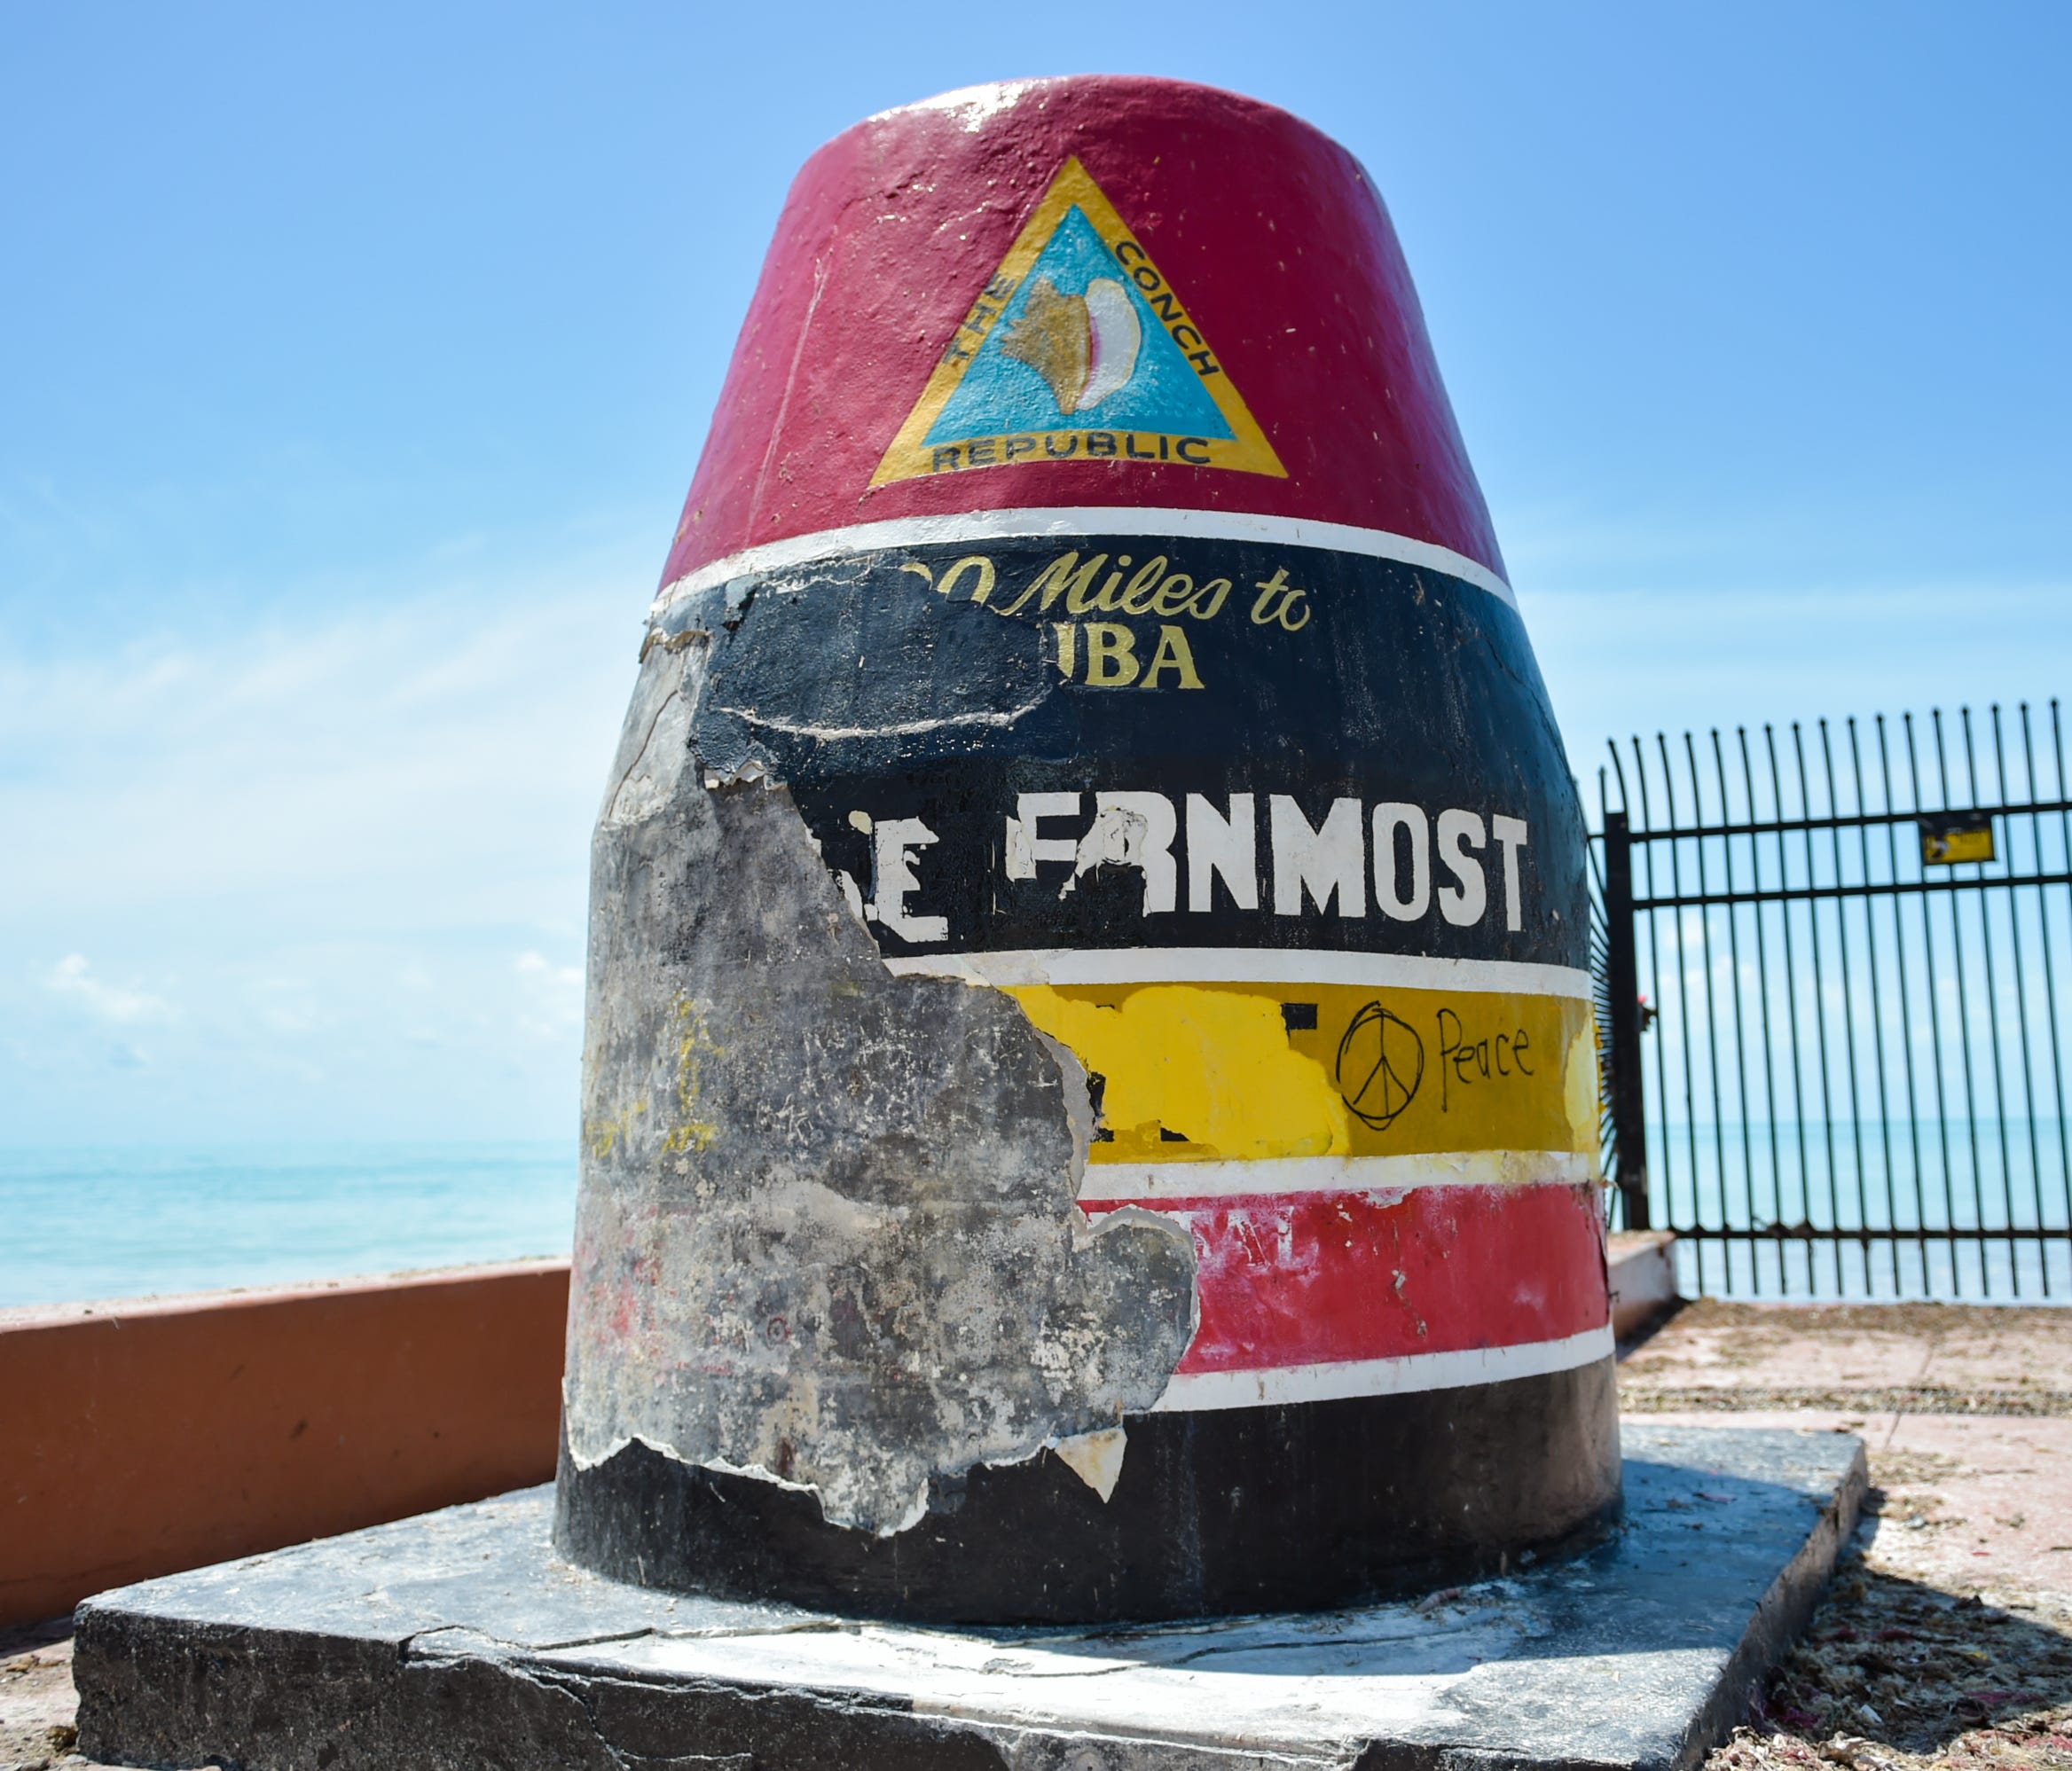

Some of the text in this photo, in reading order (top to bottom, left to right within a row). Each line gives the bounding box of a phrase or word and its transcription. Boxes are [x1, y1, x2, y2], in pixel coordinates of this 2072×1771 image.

[942, 271, 1016, 364] THE
[1115, 239, 1220, 377] CONCH
[931, 431, 1212, 473] REPUBLIC
[986, 551, 1232, 619] Miles
[1250, 566, 1311, 631] to
[1436, 1007, 1535, 1114] Peace
